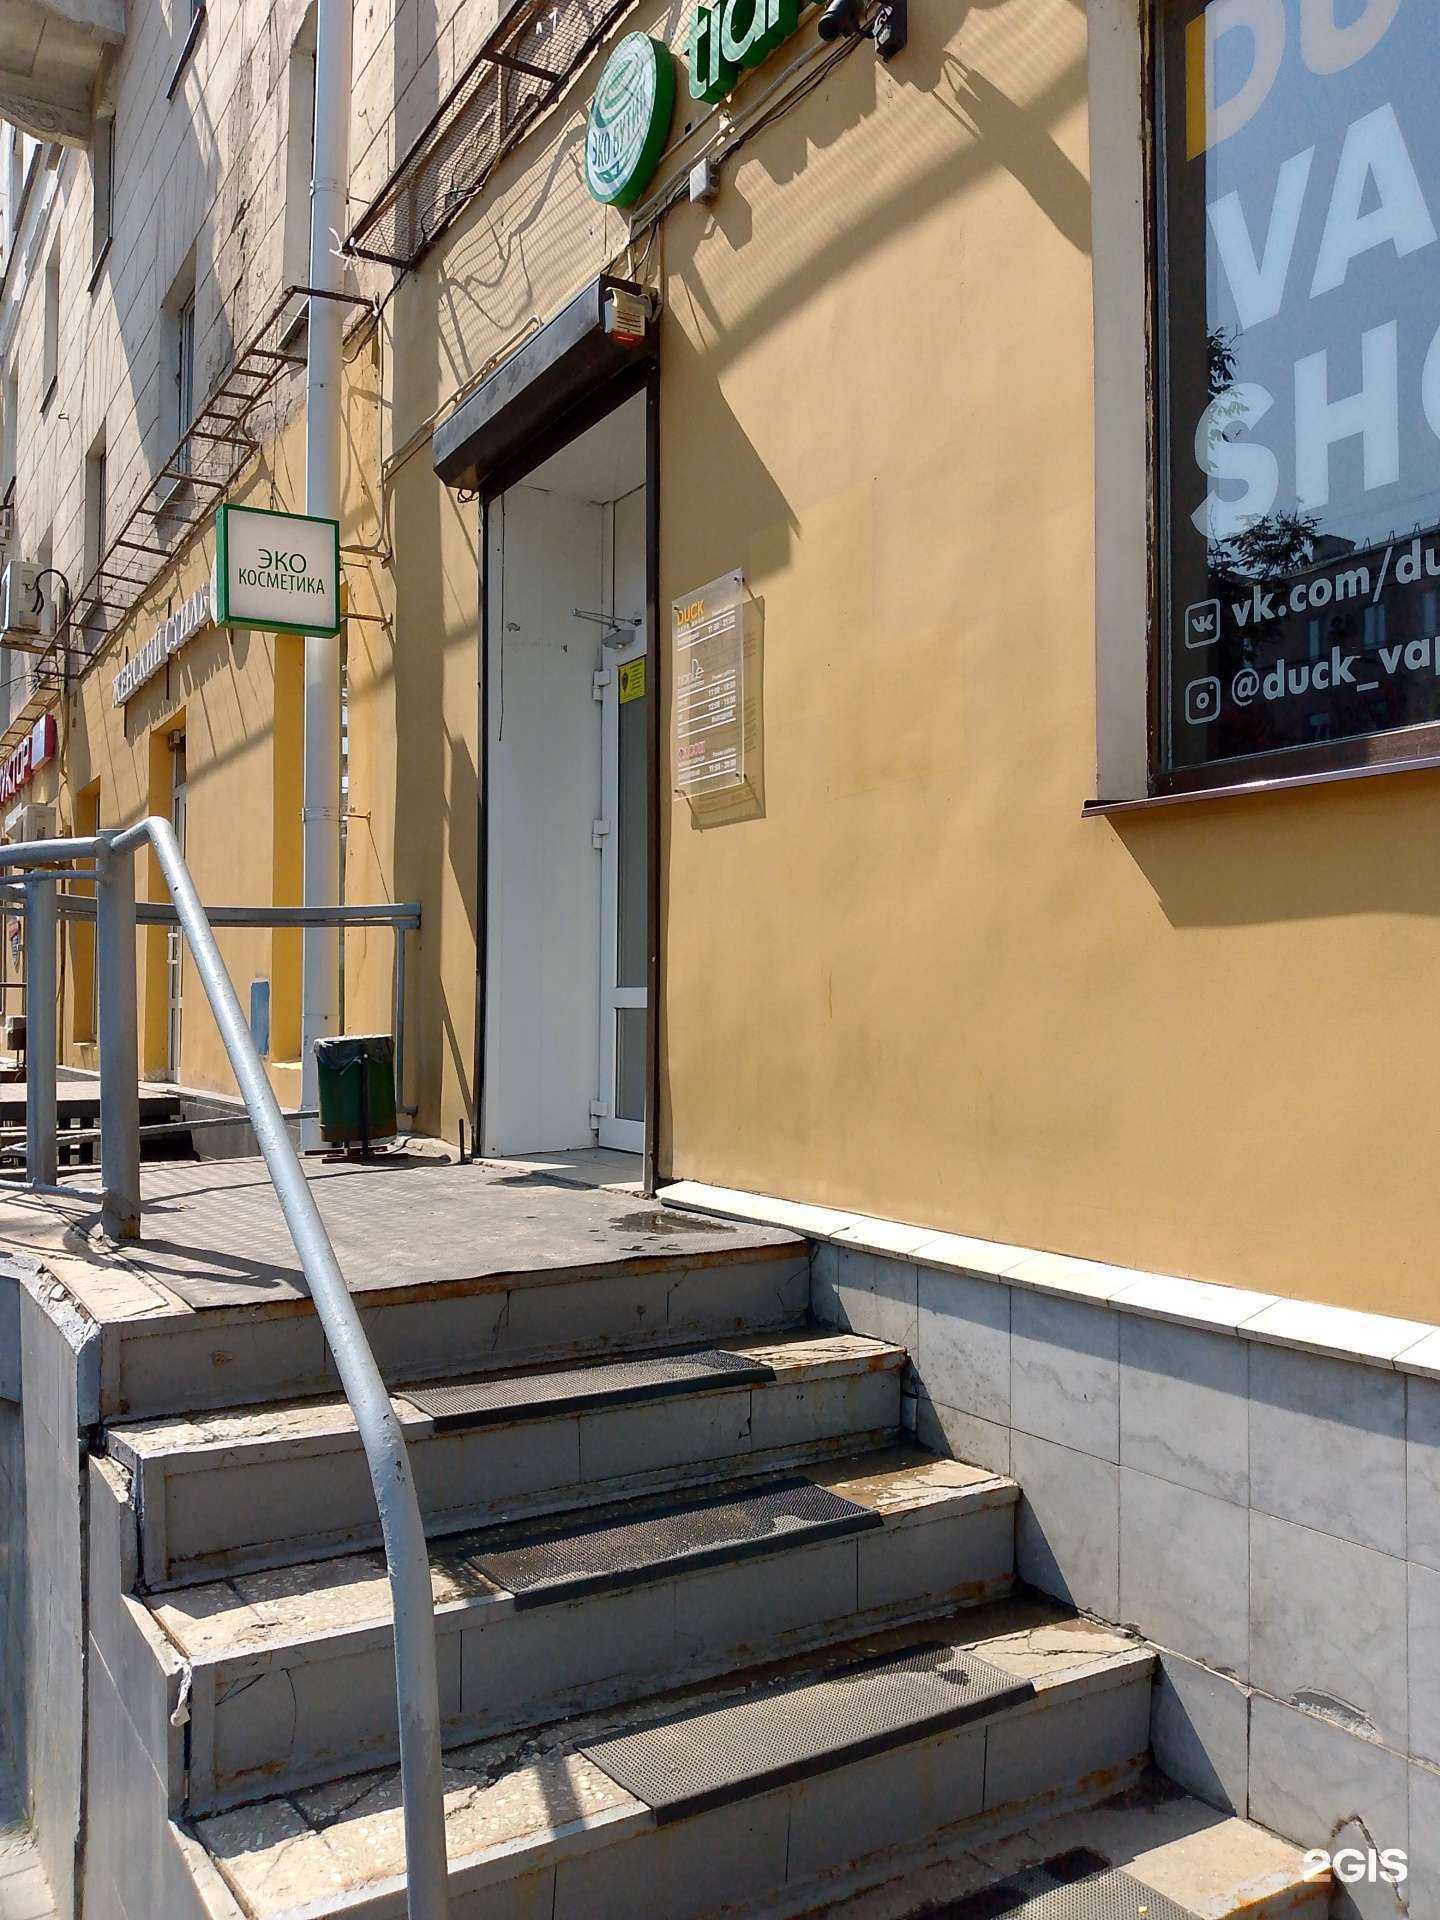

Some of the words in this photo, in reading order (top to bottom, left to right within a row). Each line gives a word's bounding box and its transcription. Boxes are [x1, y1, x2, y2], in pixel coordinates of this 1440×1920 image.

[1190, 318, 1440, 541] SH
[258, 548, 307, 574] ЭКО
[239, 567, 325, 595] КОСМЕТИКА
[677, 600, 704, 626] DUCK
